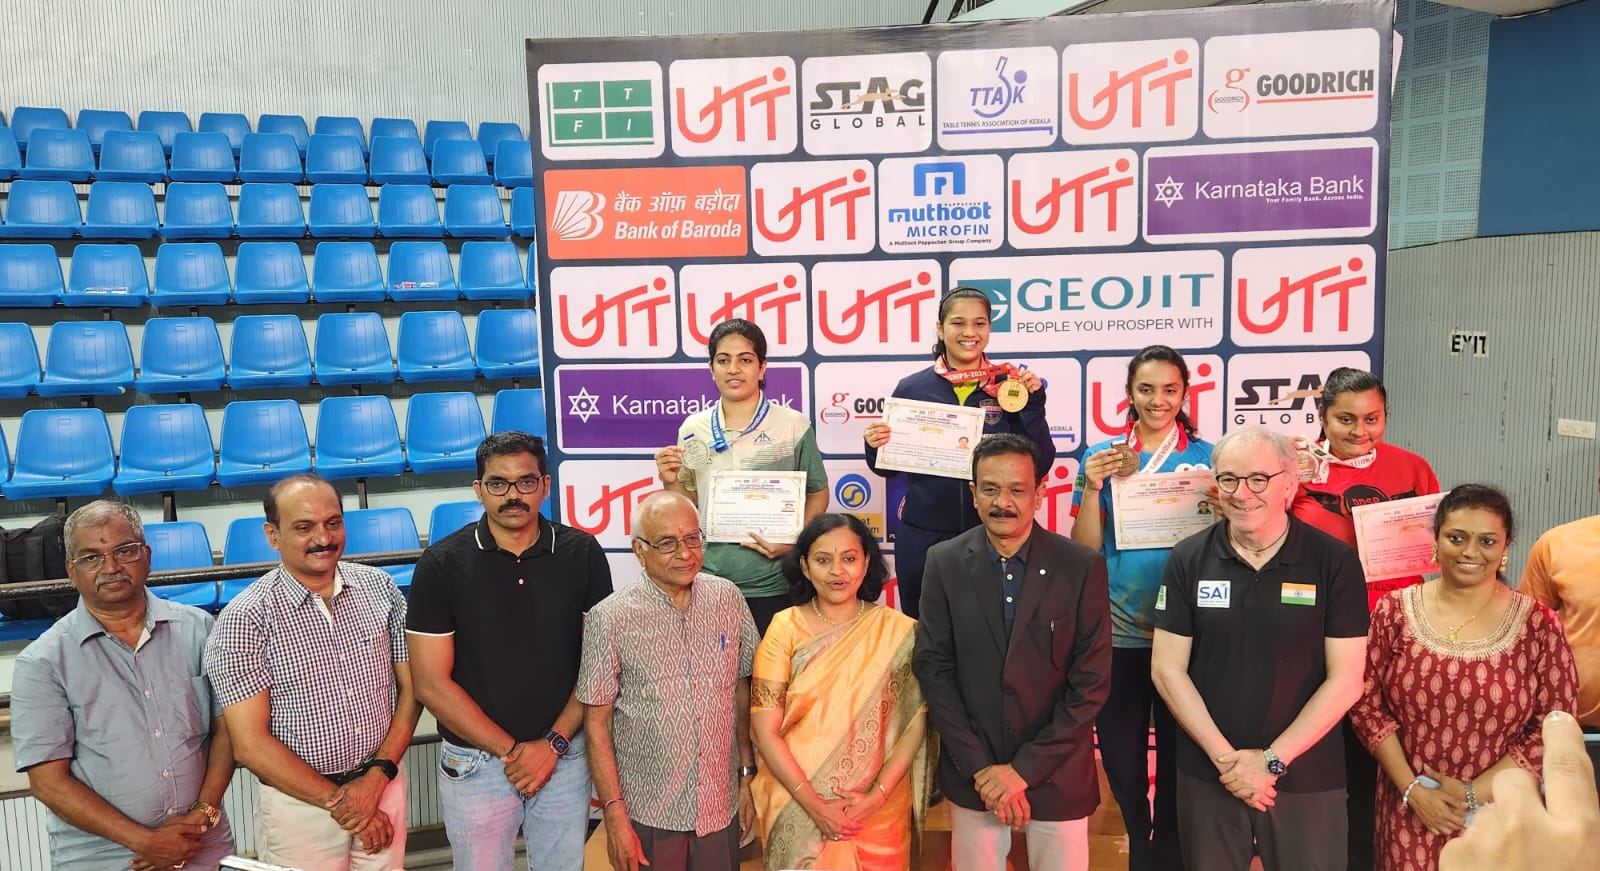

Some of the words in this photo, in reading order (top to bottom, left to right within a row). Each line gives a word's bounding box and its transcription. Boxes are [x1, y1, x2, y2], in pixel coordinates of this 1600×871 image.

[1257, 69, 1375, 97] GOODRICH
[810, 76, 926, 114] STAG
[810, 114, 926, 130] GLOBAL
[982, 119, 1019, 127] ASSOCIATION
[1195, 177, 1301, 200] Karnataka
[1310, 174, 1364, 195] Bank
[613, 190, 643, 213] बैंक
[888, 201, 992, 223] muthoot
[614, 221, 658, 240] Bank
[661, 220, 679, 239] of
[680, 219, 742, 238] Baroda
[906, 224, 989, 238] MICROFIN
[1016, 273, 1215, 313] GEOJIT
[1016, 321, 1070, 333] PEOPLE
[1074, 320, 1103, 332] YOU
[1107, 318, 1174, 331] PROSPER
[1177, 317, 1213, 329] WITH
[1234, 374, 1324, 411] STA
[612, 394, 720, 415] Karnatak
[1234, 413, 1316, 425] GLOB
[1199, 586, 1228, 600] SAI
